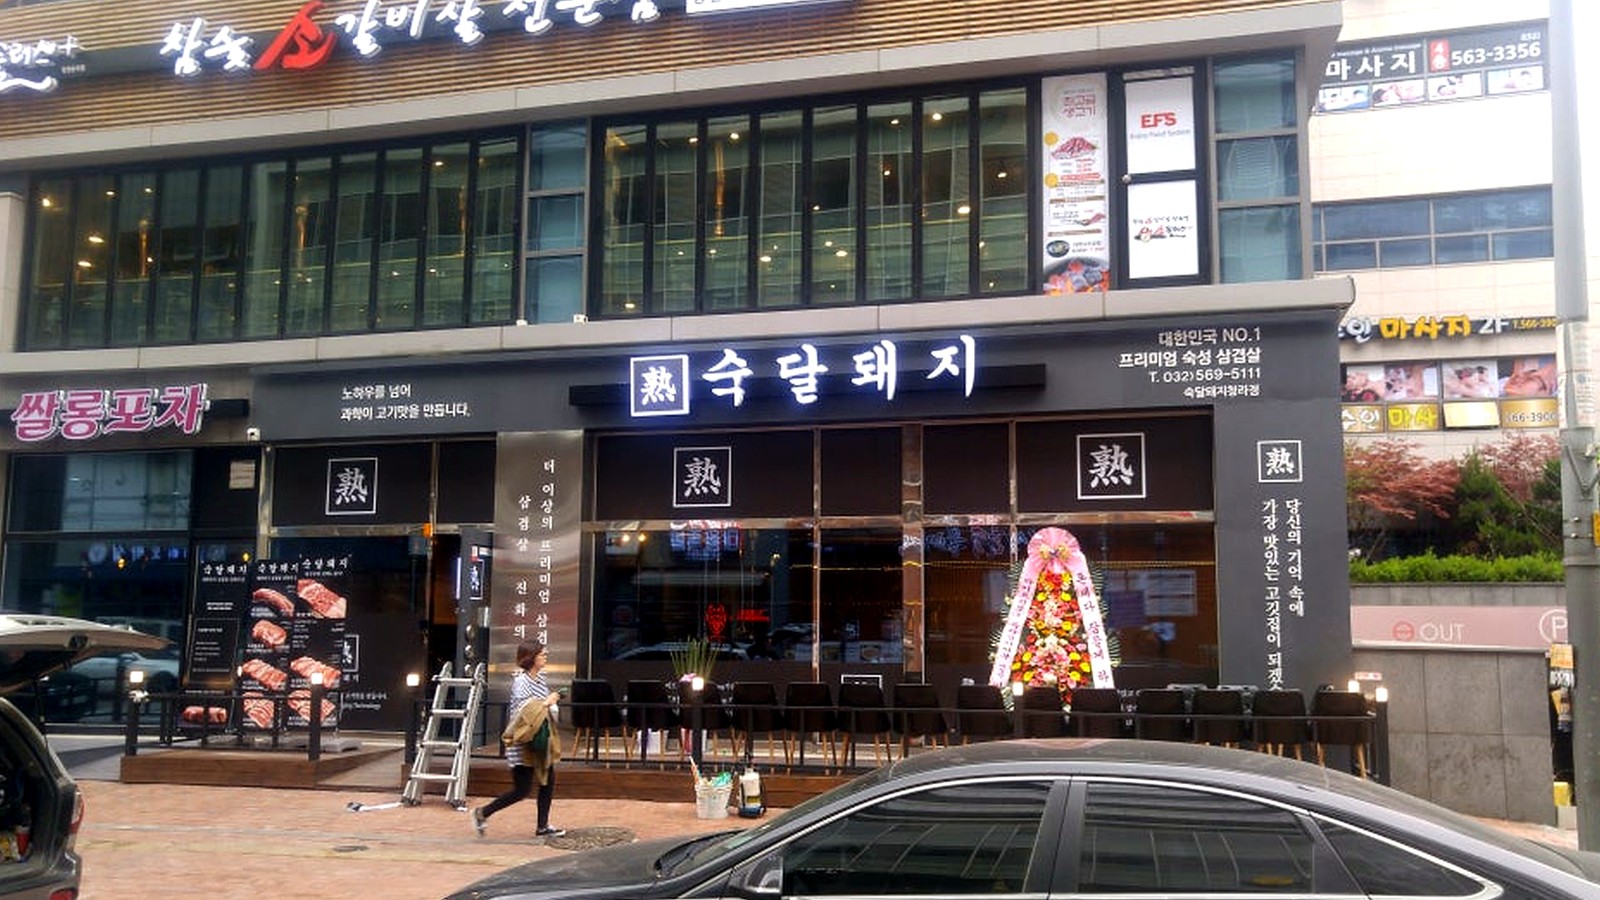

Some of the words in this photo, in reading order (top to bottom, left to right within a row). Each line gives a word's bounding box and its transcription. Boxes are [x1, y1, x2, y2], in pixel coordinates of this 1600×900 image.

[1325, 50, 1416, 81] 마사지
[1451, 41, 1541, 66] 563-3356
[1141, 112, 1177, 128] EFS
[1158, 329, 1218, 346] 대한민국
[1222, 327, 1261, 342] NO.1
[1338, 318, 1372, 343] 인
[1379, 314, 1472, 340] 마사지
[1478, 318, 1510, 334] 2F
[702, 335, 975, 407] 숙달돼지
[1118, 350, 1177, 368] 프리미엄
[1182, 349, 1212, 366] 숙성
[1215, 347, 1261, 364] 삼겹살
[342, 385, 385, 400] 노하우를
[389, 383, 412, 399] 넘어
[11, 383, 208, 441] 쌀롱포차
[340, 405, 373, 421] 과학이
[375, 403, 420, 420] 고기맛을
[423, 402, 471, 418] 만듭니다.
[543, 459, 555, 474] 더
[540, 483, 555, 530] 이상의
[1262, 498, 1279, 531] 가장
[1286, 499, 1302, 545] 당신의
[516, 495, 531, 552] 삼겹살
[538, 540, 553, 604] 프리미엄
[1263, 532, 1280, 582] 맛있는
[1288, 549, 1302, 581] 기억
[514, 580, 527, 639] 진화의
[1289, 585, 1305, 617] 속에
[1420, 622, 1465, 641] OUT
